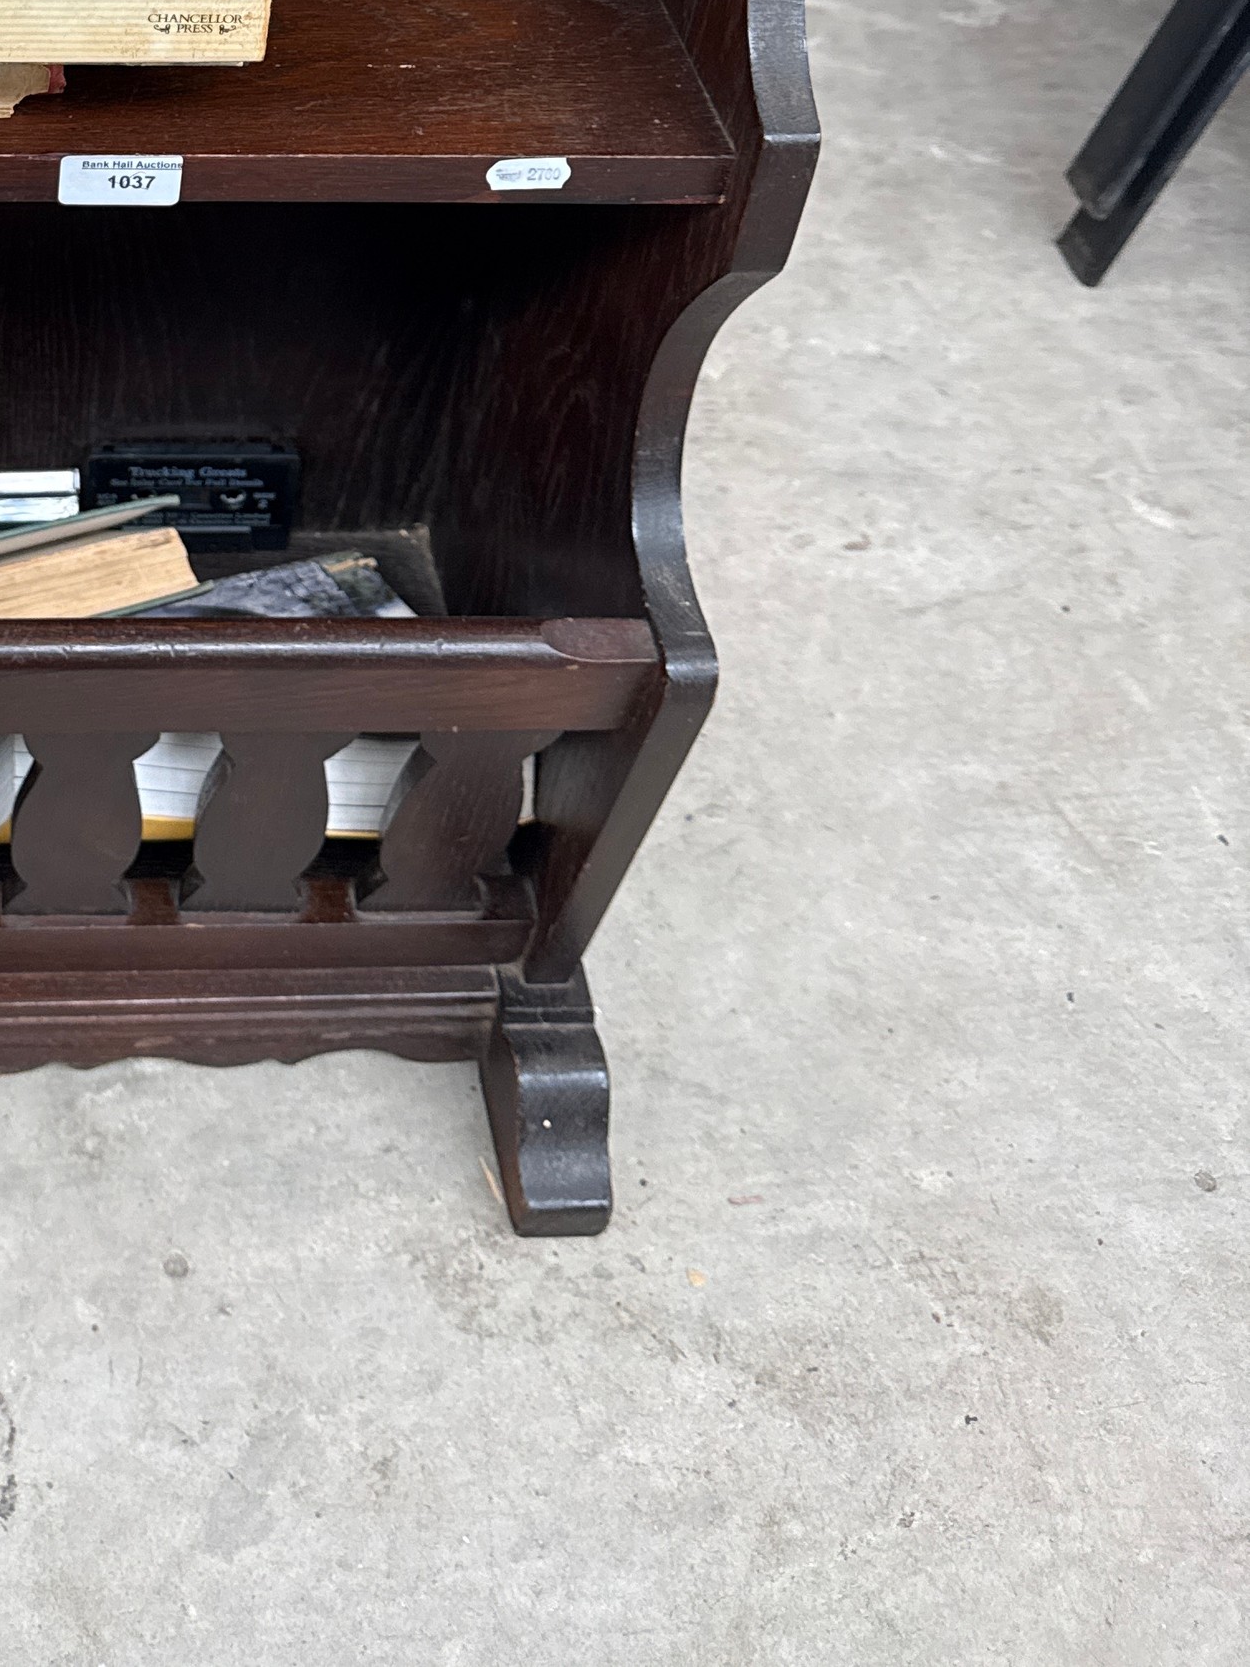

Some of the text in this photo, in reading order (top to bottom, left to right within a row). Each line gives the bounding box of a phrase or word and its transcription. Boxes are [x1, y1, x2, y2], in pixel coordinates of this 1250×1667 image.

[147, 13, 243, 24] CHANCELLOR
[176, 23, 214, 34] PRESS
[82, 160, 109, 169] Bank
[112, 160, 133, 169] Hall
[107, 175, 156, 190] 1037
[128, 465, 196, 480] Trucking
